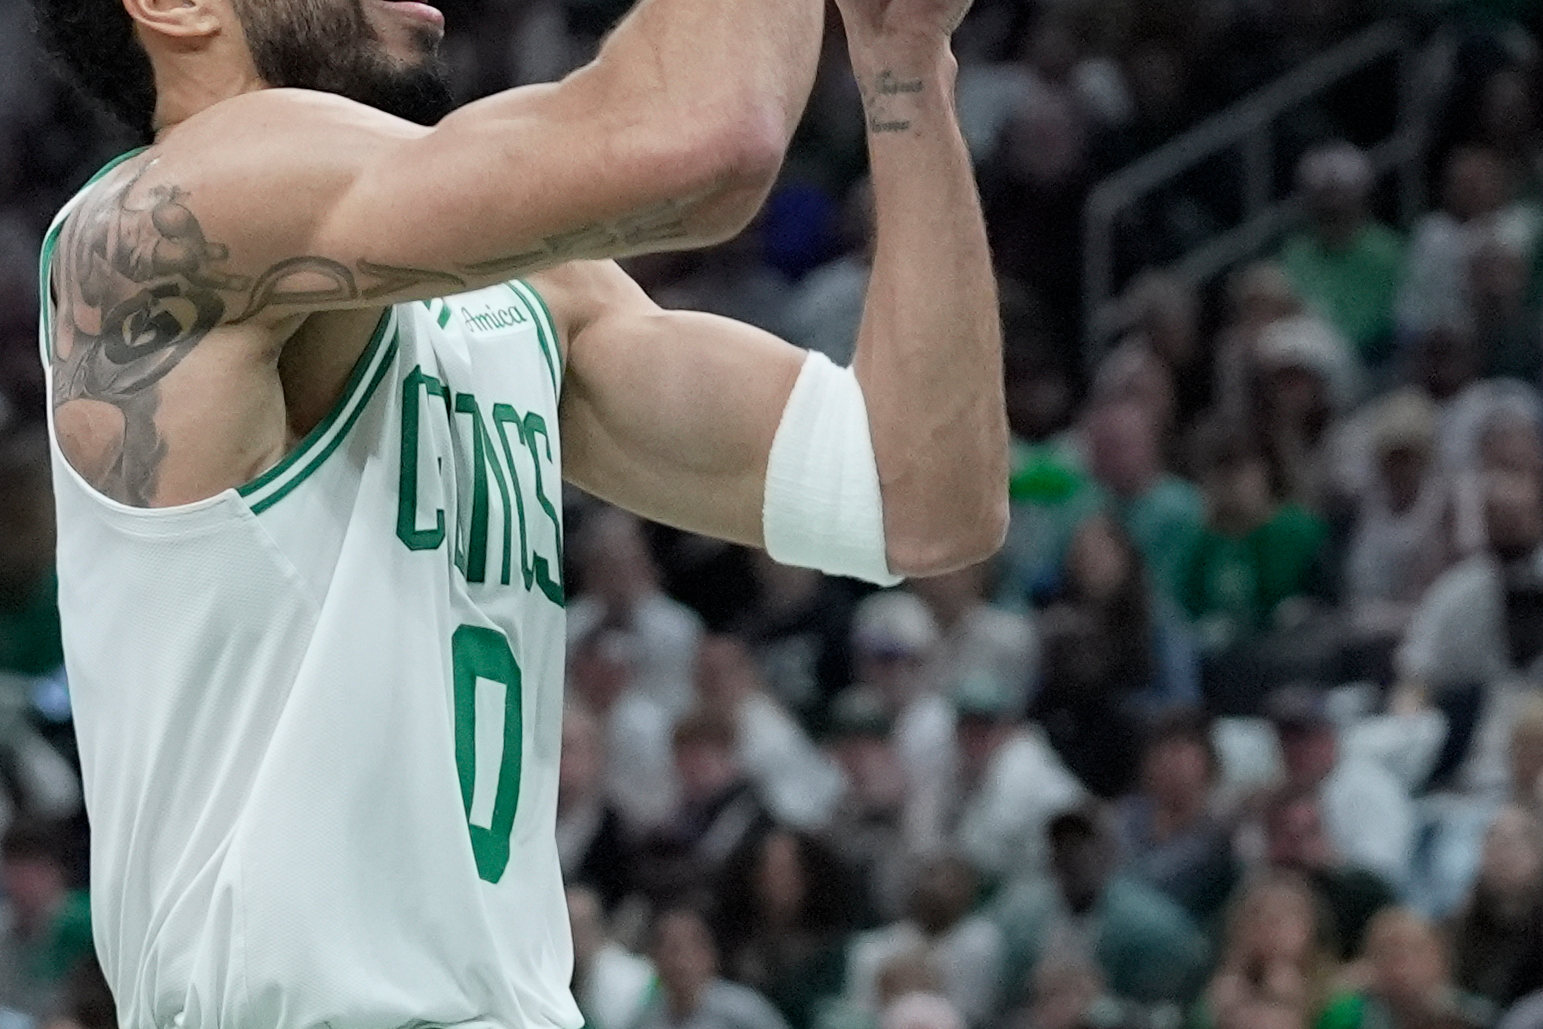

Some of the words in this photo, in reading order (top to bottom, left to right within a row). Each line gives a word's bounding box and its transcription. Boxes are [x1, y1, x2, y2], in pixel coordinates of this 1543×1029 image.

[461, 303, 528, 333] Amica
[396, 364, 565, 608] CTICS
[451, 623, 523, 885] 0
